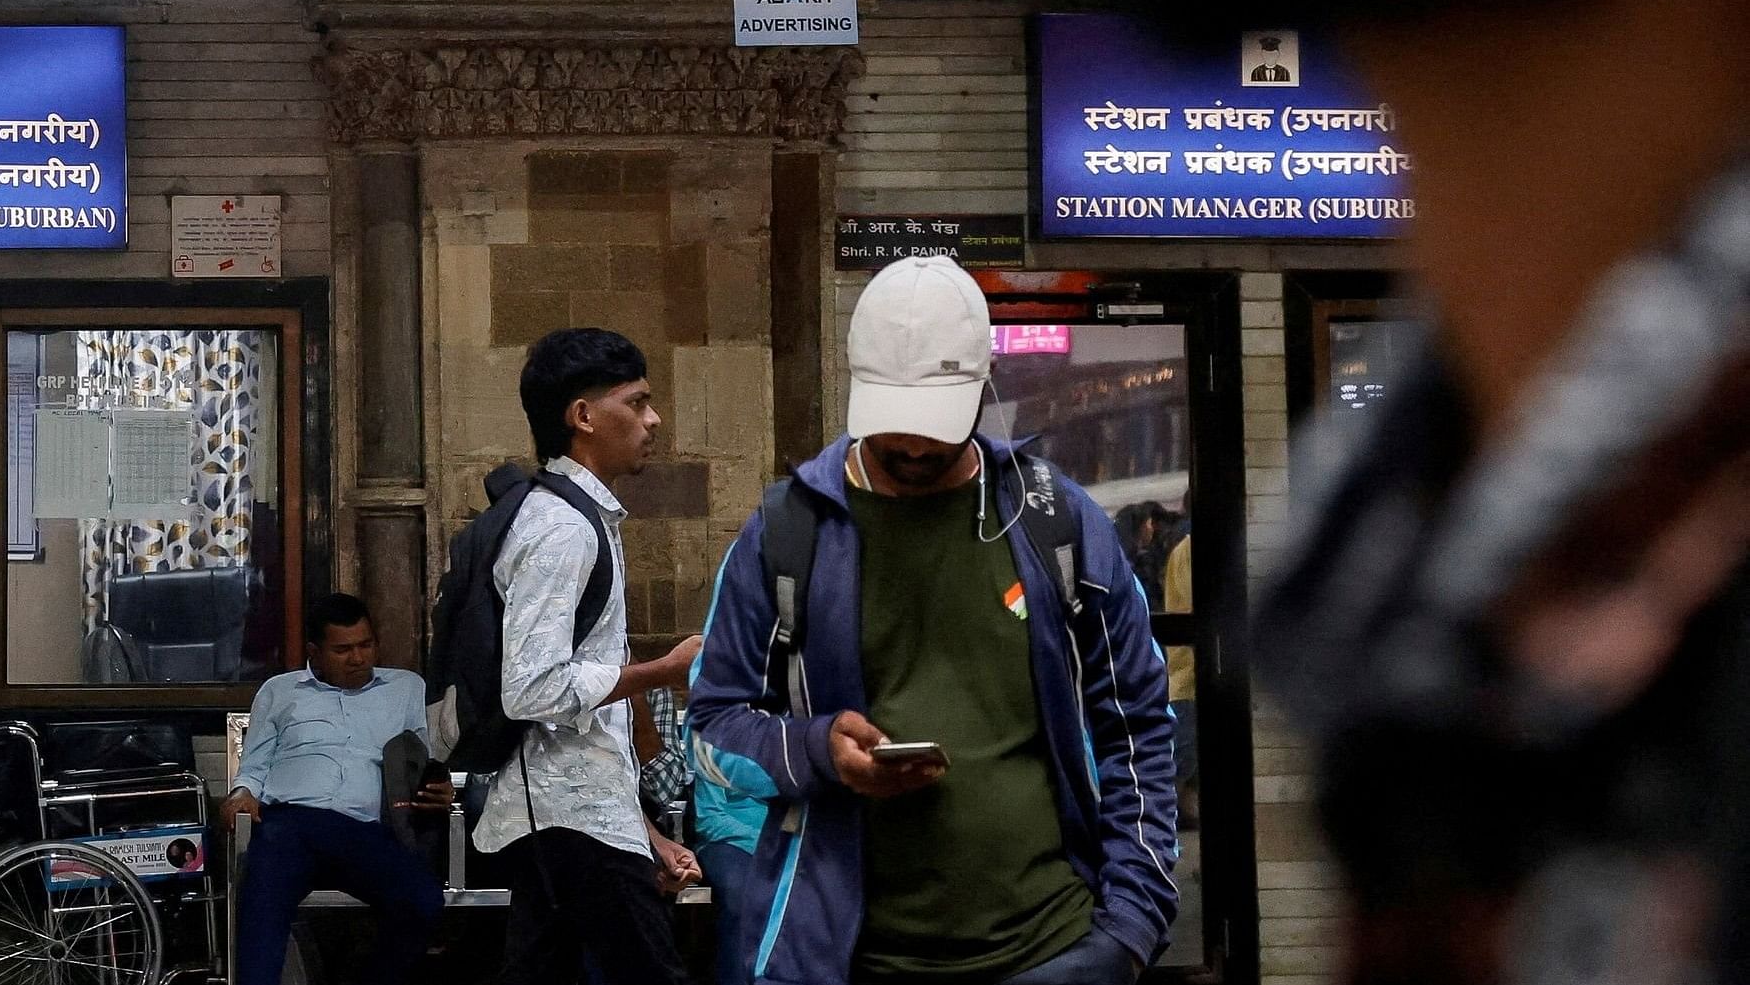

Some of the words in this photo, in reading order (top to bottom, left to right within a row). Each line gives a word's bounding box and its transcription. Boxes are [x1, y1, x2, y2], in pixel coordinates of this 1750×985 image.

[740, 18, 852, 33] ADVERTISING
[1084, 100, 1170, 131] स्टेशन
[1183, 100, 1274, 131] प्रबंधक
[1084, 143, 1171, 175] स्टेशन
[1183, 143, 1275, 175] प्रबंधक
[1056, 197, 1165, 219] STATION
[1171, 197, 1304, 219] MANAGER
[1309, 196, 1416, 224] (SUBURB
[841, 246, 871, 257] Shri.
[875, 246, 889, 257] R.
[893, 246, 906, 257] K.
[910, 246, 959, 258] PANDA
[121, 855, 140, 864] AST
[142, 854, 166, 863] MILE
